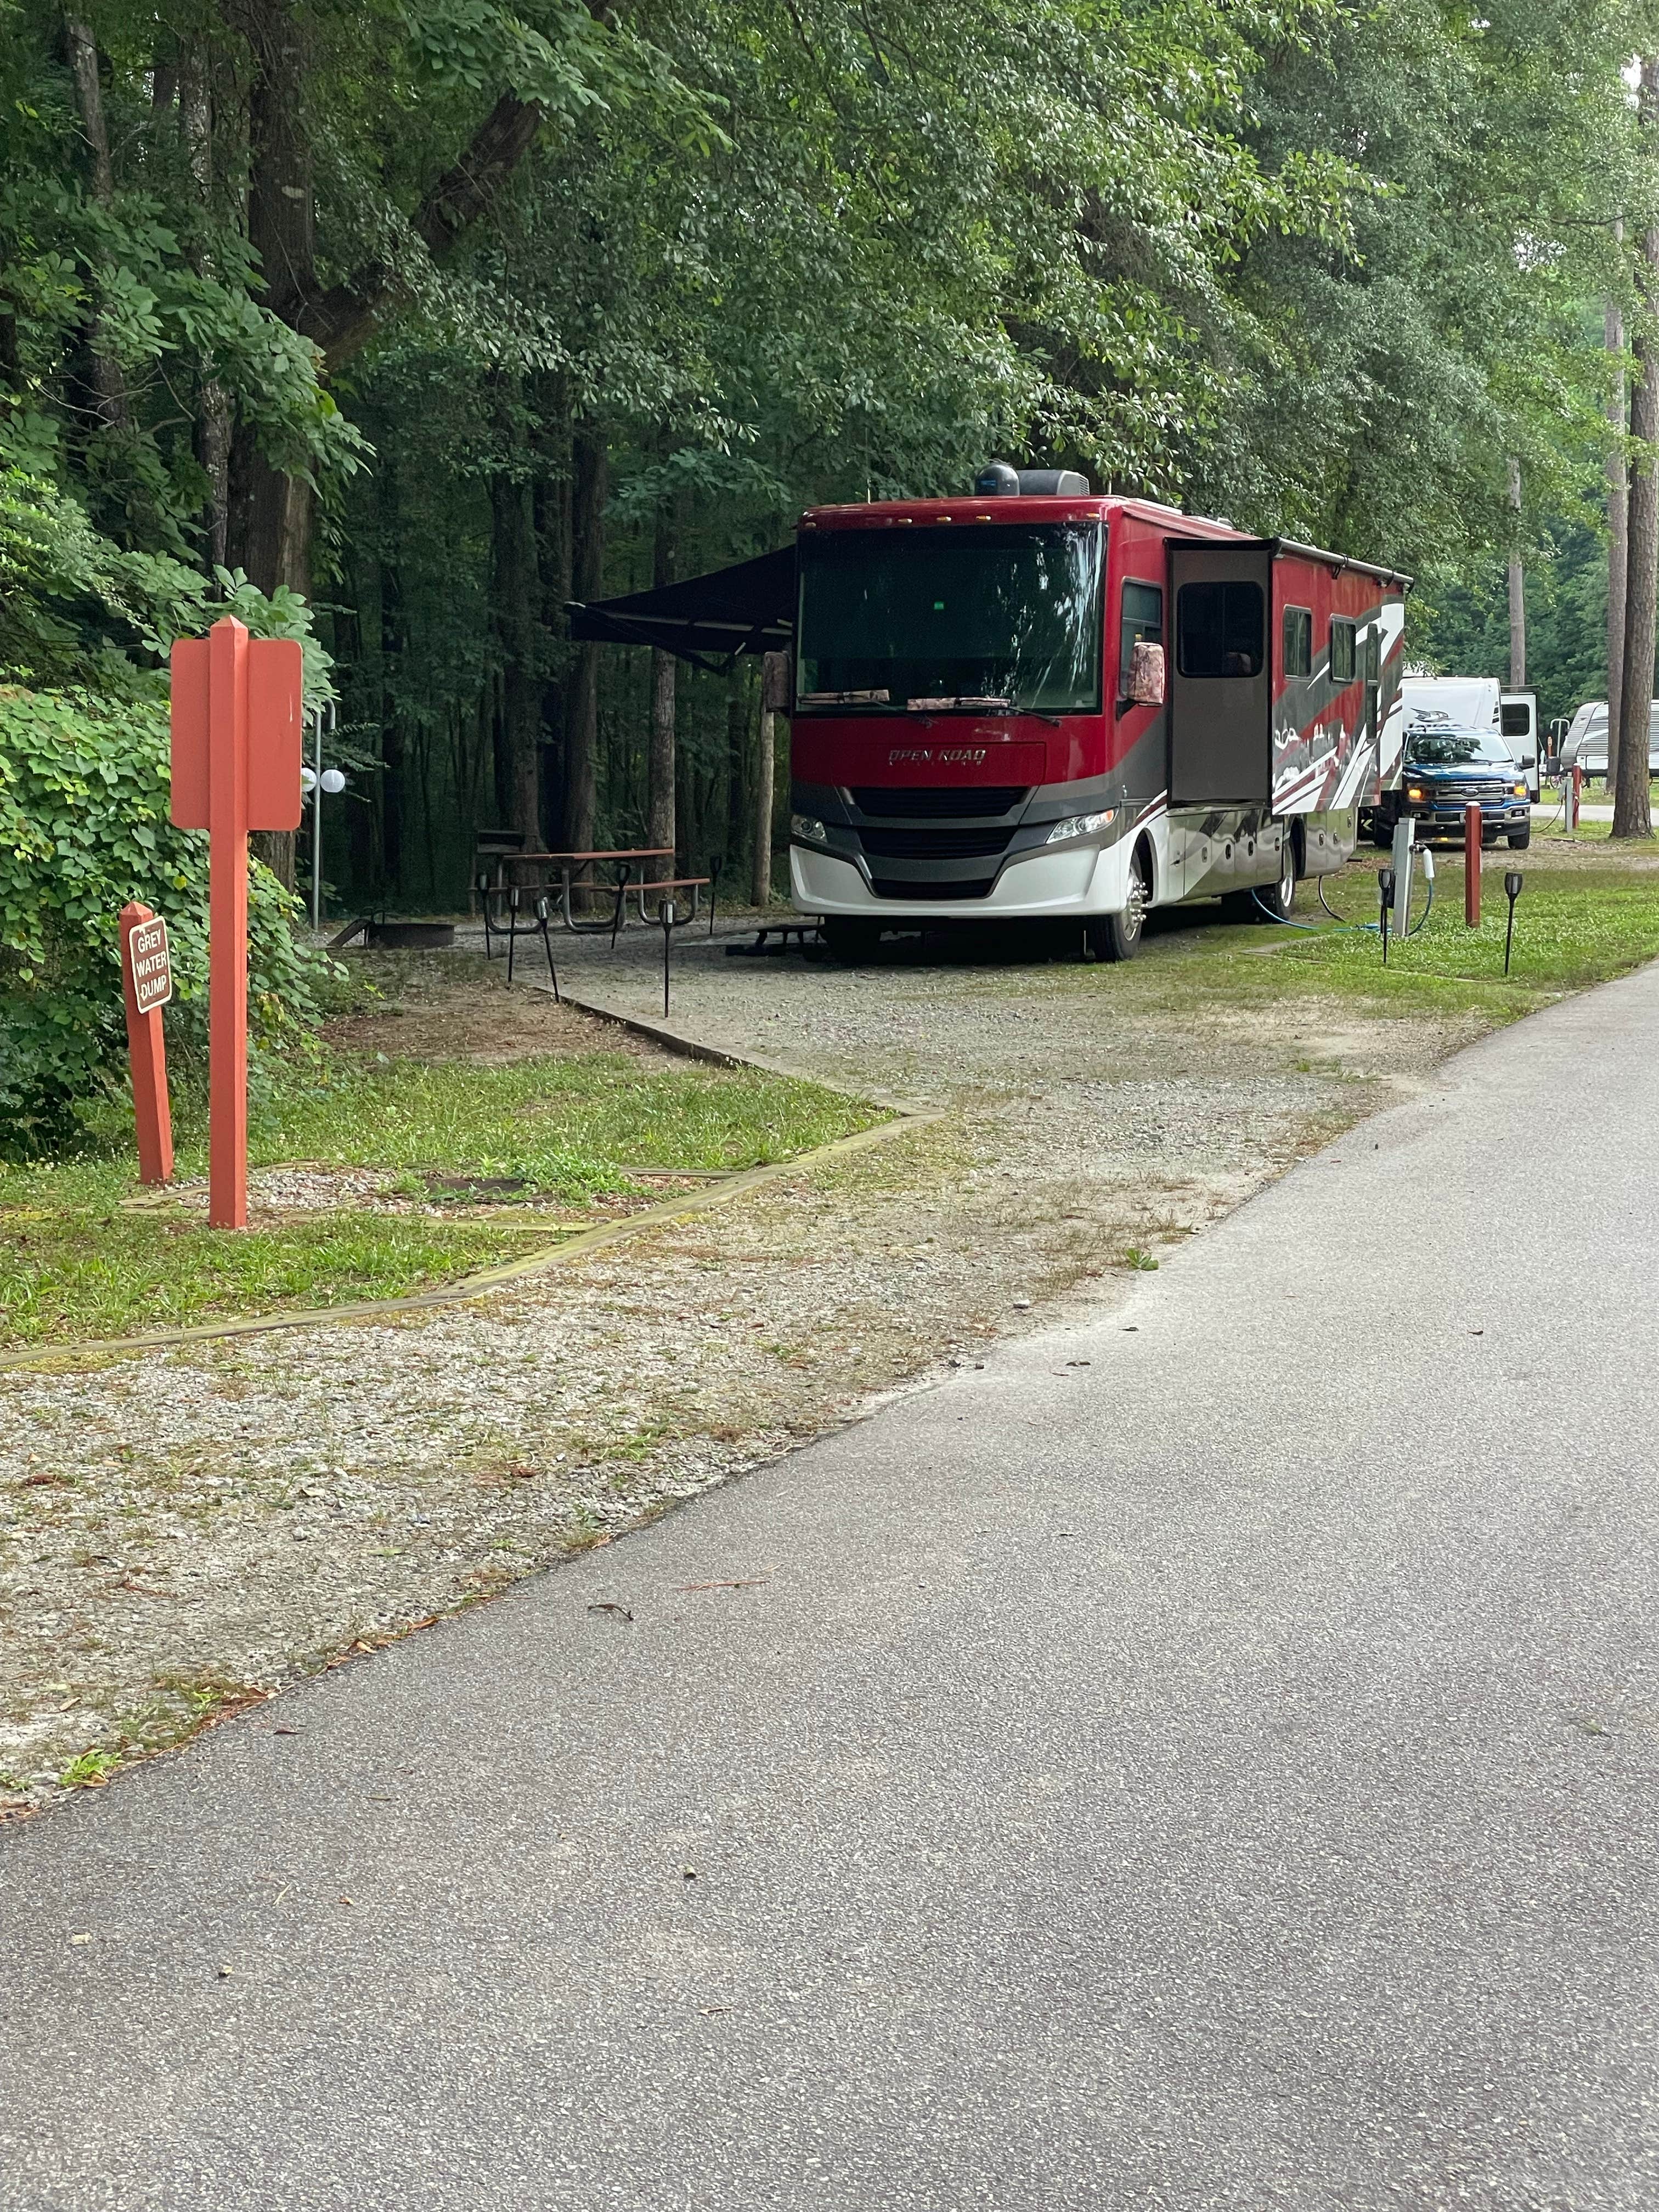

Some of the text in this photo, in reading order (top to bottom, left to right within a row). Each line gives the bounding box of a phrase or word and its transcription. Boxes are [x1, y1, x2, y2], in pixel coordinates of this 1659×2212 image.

[889, 749, 986, 761] OPEN ROAD
[138, 929, 161, 953] GREY
[136, 951, 167, 978] WATER
[140, 974, 167, 1001] DUMP
